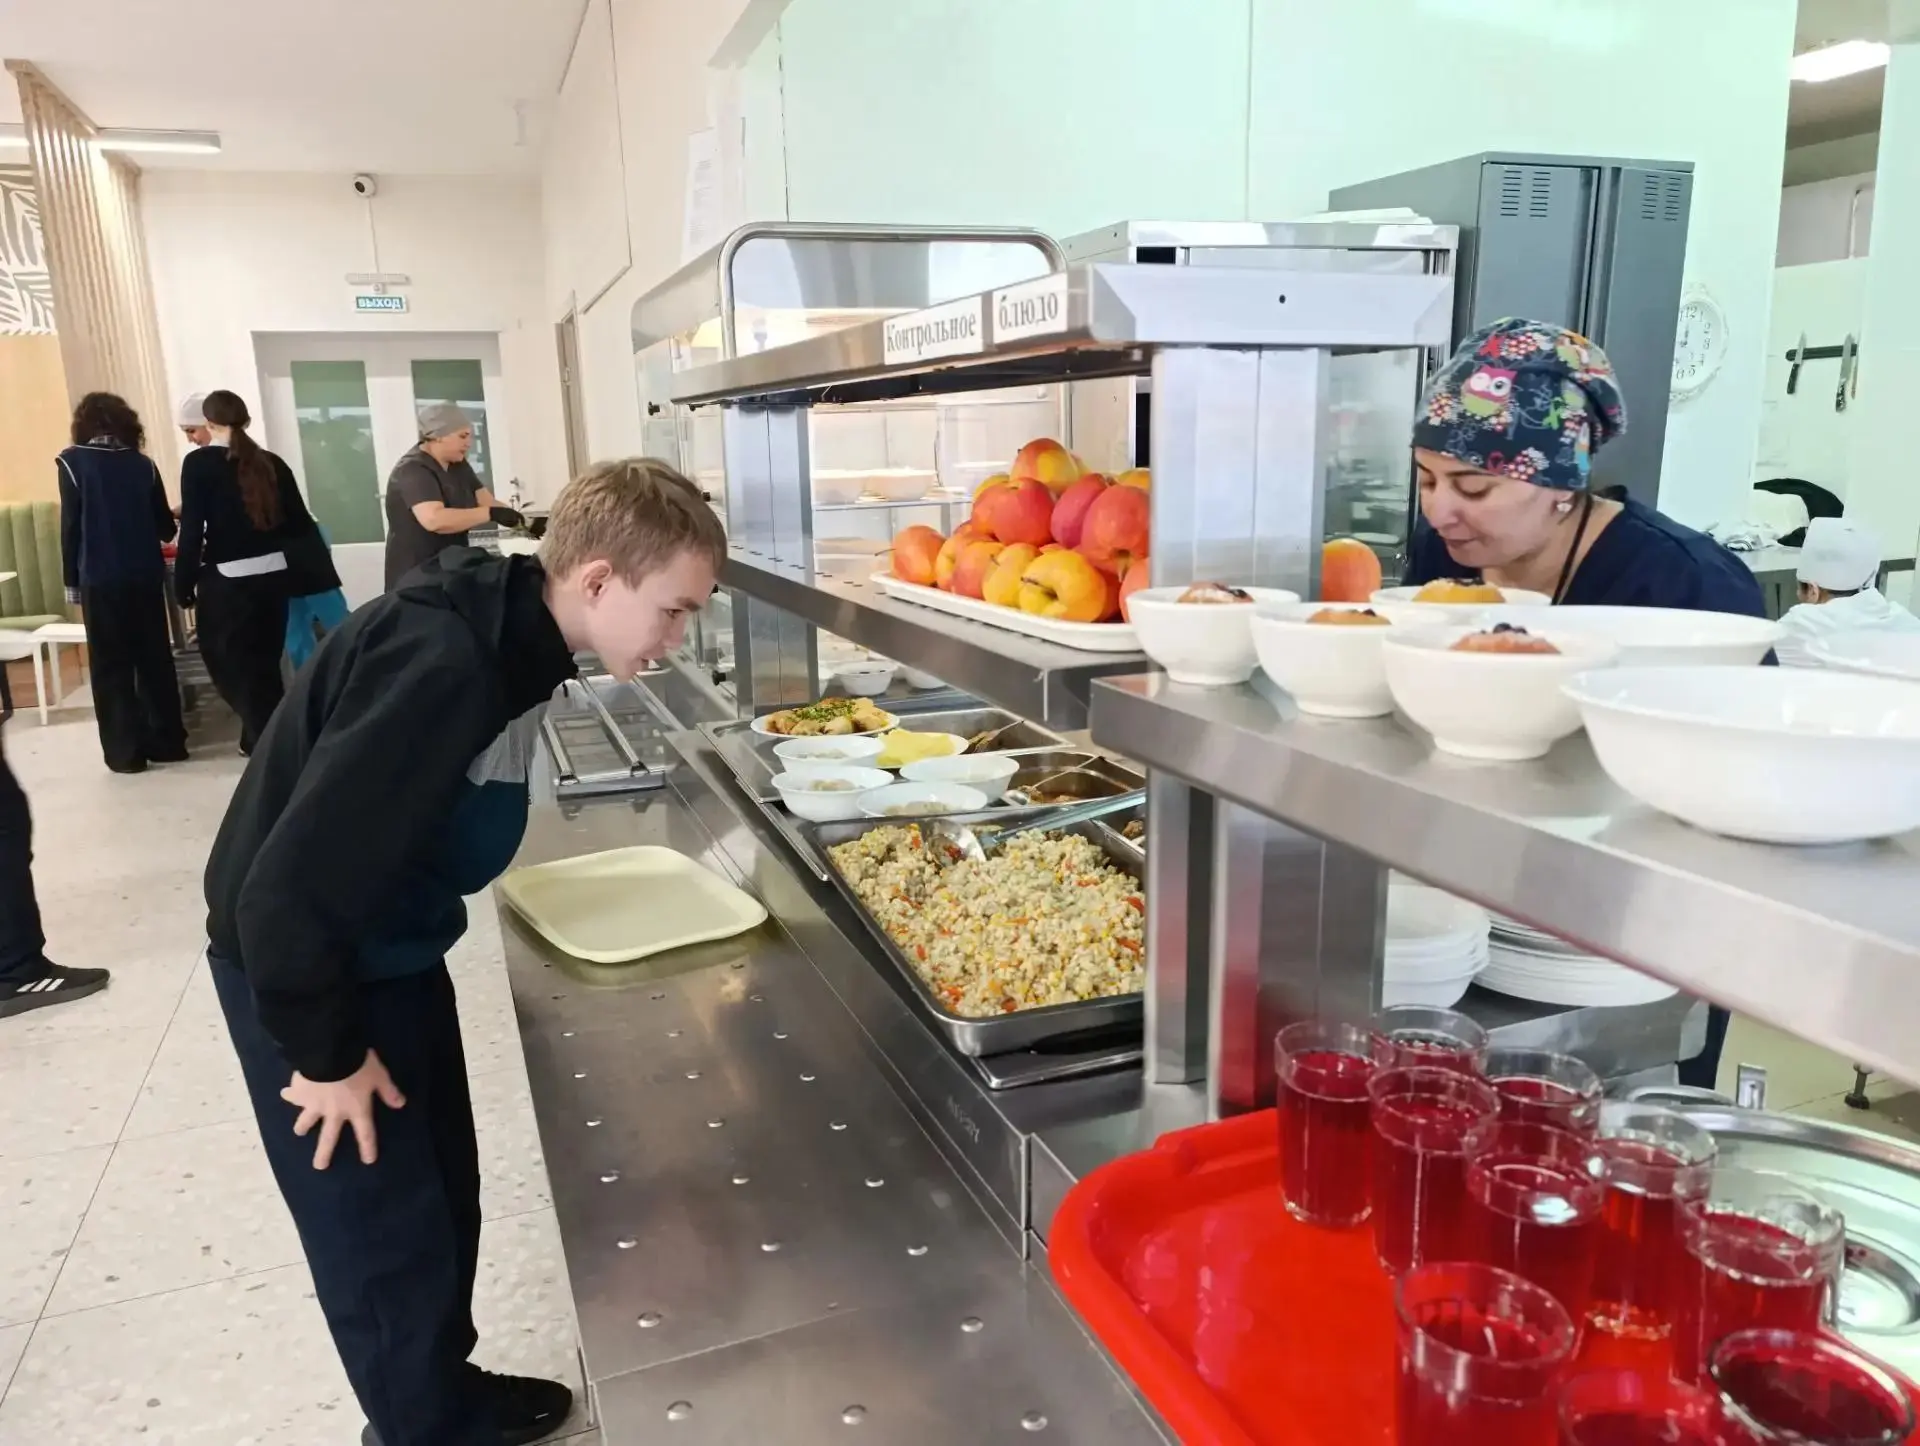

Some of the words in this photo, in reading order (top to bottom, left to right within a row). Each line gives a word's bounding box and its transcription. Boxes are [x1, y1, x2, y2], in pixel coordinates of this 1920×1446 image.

[358, 297, 401, 309] ВЫХОД
[887, 312, 976, 355] Контрольное
[999, 292, 1058, 330] блюдо
